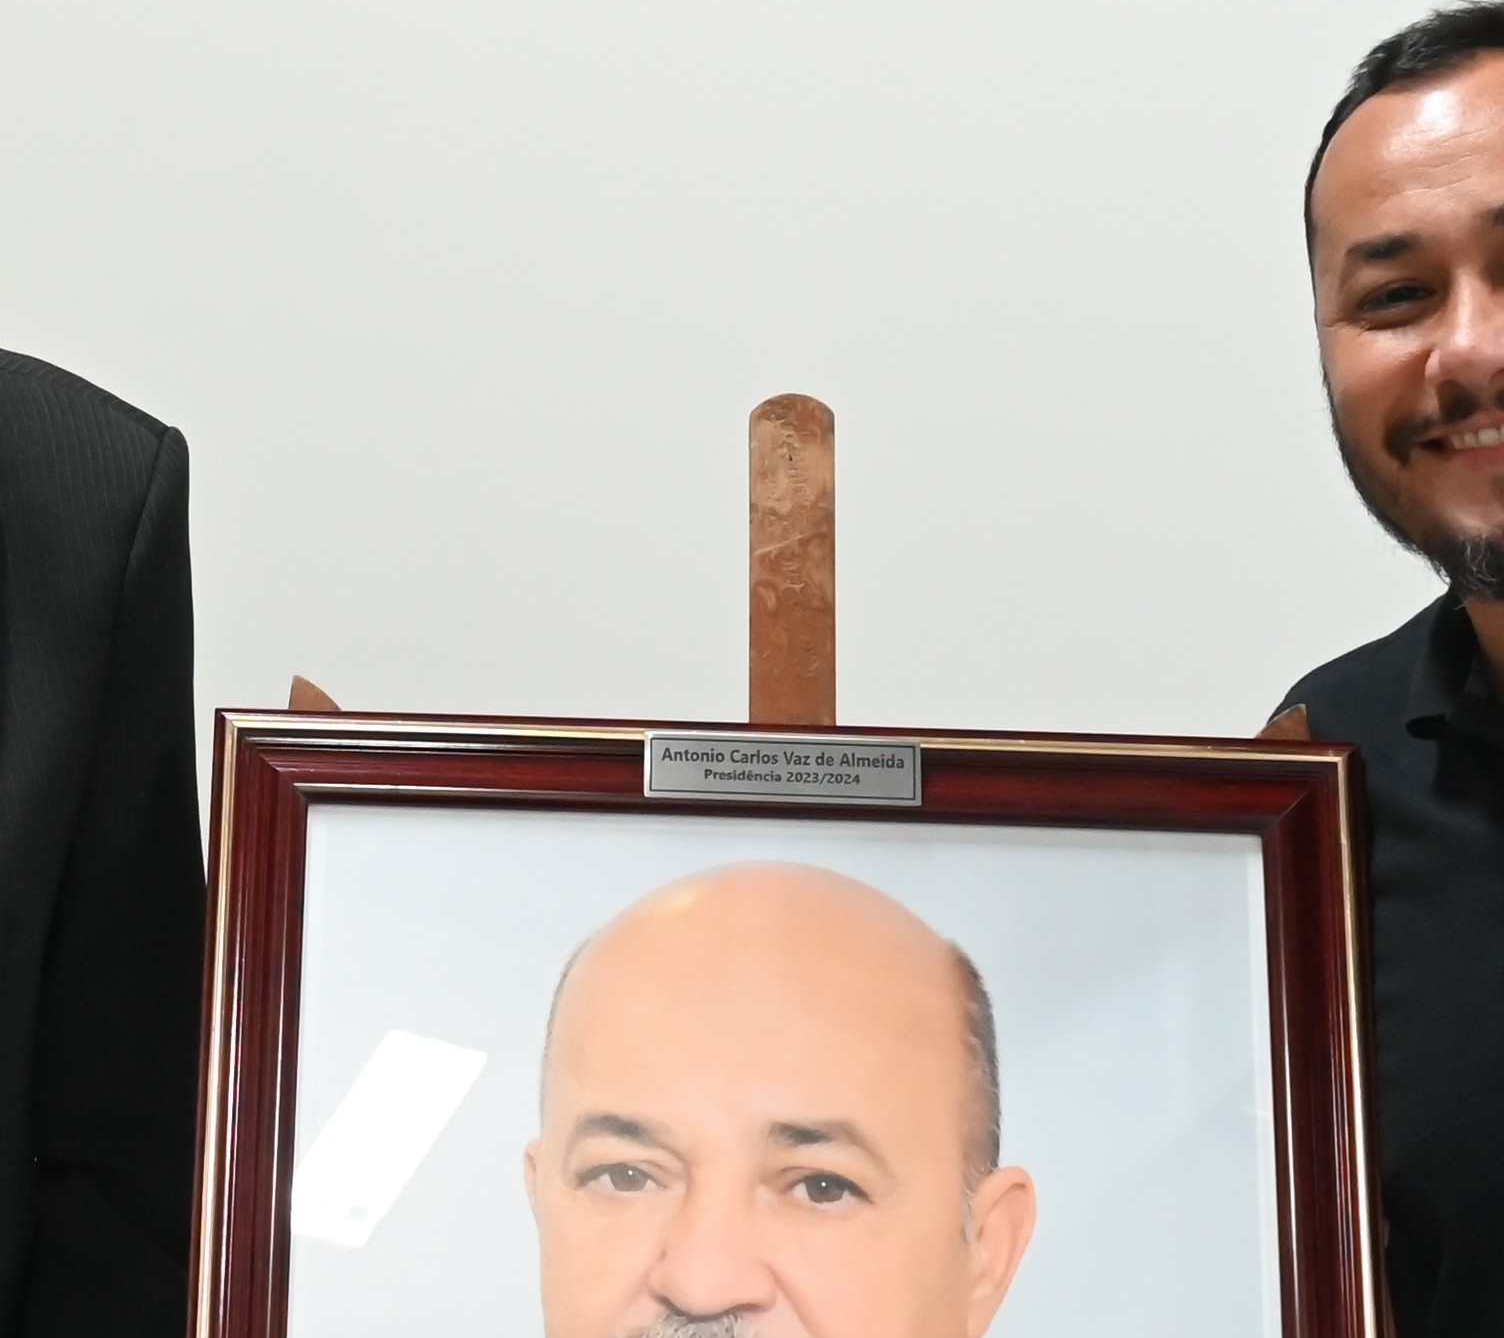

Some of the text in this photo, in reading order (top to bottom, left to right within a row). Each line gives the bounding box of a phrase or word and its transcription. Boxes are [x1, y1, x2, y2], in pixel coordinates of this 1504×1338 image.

[661, 746, 905, 770] Antonio Carlos Vaz de Almeida
[703, 768, 861, 786] Presidência 2023/2024
